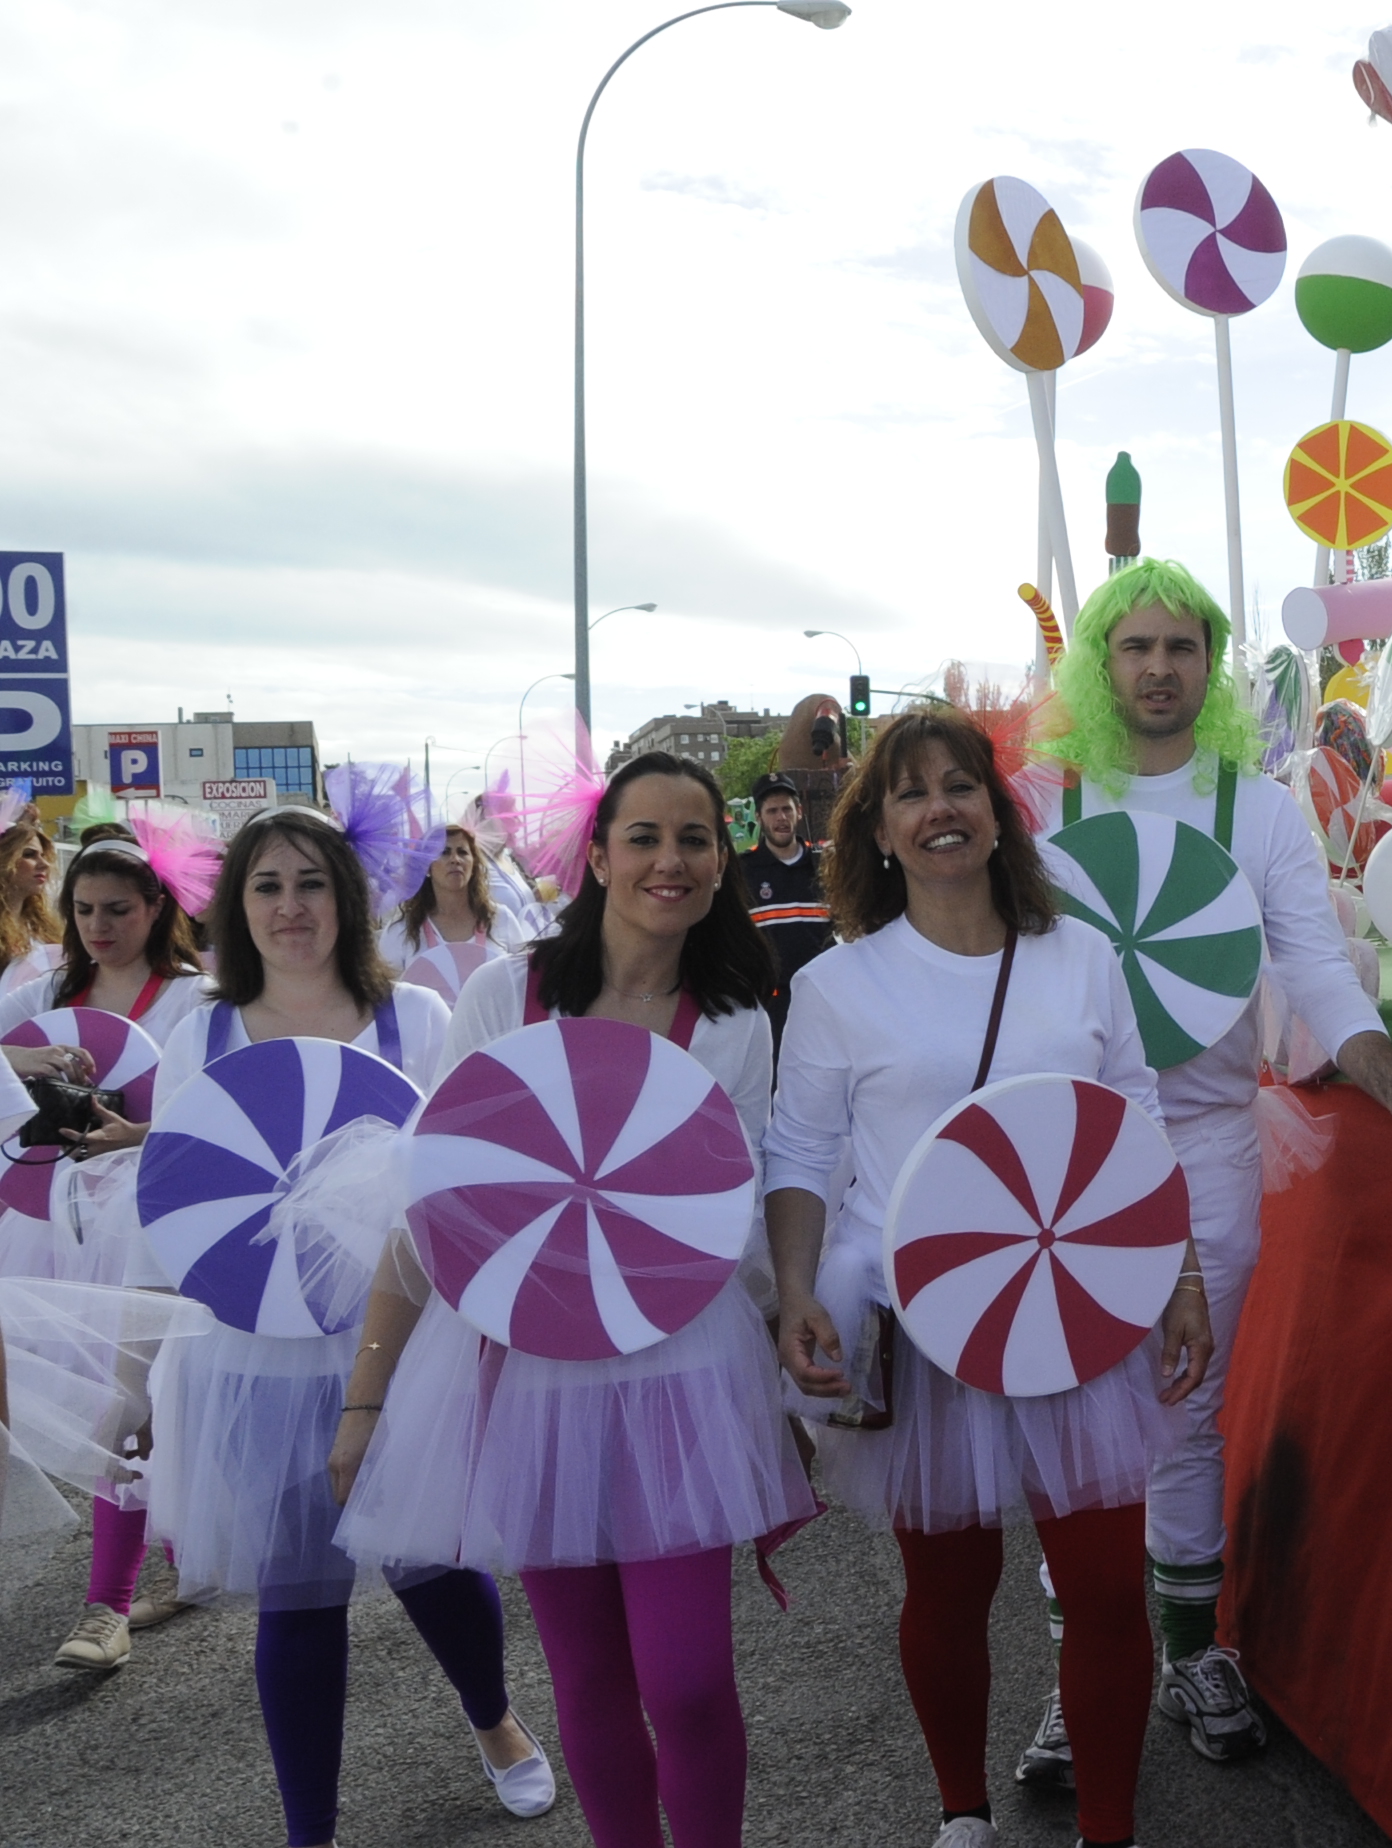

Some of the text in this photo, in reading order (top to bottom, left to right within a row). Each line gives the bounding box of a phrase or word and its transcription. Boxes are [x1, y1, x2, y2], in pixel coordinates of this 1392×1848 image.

[0, 562, 55, 630] 0
[130, 733, 158, 744] CHINA
[121, 750, 148, 784] P
[204, 781, 265, 798] EXPOSICION
[209, 800, 262, 808] COCINAS
